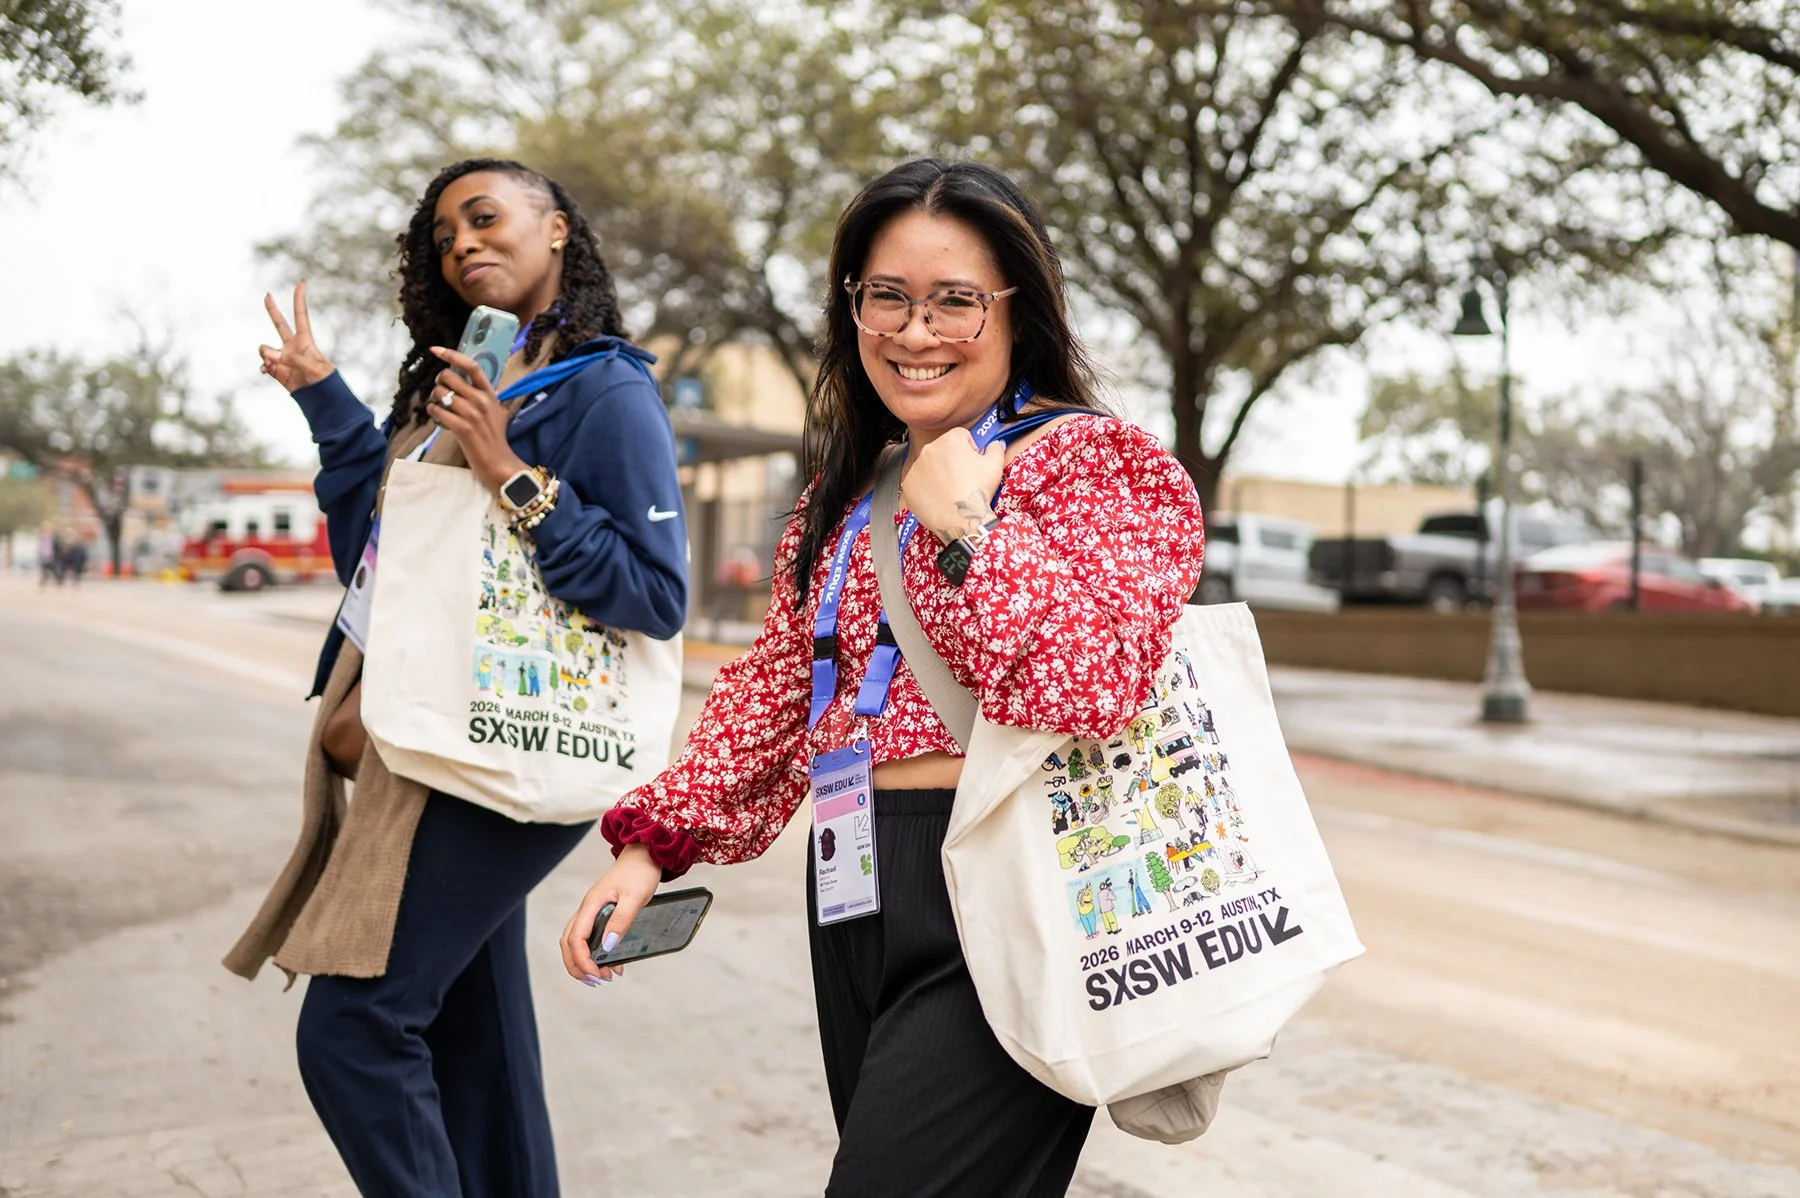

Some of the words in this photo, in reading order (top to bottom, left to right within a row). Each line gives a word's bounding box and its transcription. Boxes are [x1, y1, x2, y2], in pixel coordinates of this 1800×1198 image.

[828, 566, 842, 591] EDU
[468, 716, 549, 751] SXSW
[556, 729, 609, 763] EDU
[470, 701, 501, 713] 2026
[506, 708, 549, 722] MARCH
[553, 712, 572, 728] 9-12
[622, 731, 636, 742] TX
[816, 783, 834, 798] SXSW
[835, 778, 847, 791] EDU
[819, 866, 837, 875] Rachael
[1080, 945, 1120, 971] 2026
[1126, 924, 1180, 956] MARCH
[1180, 910, 1214, 934] 9-12
[1220, 896, 1262, 920] AUSTIN,
[1259, 887, 1282, 908] TX
[1195, 917, 1263, 970] EDU
